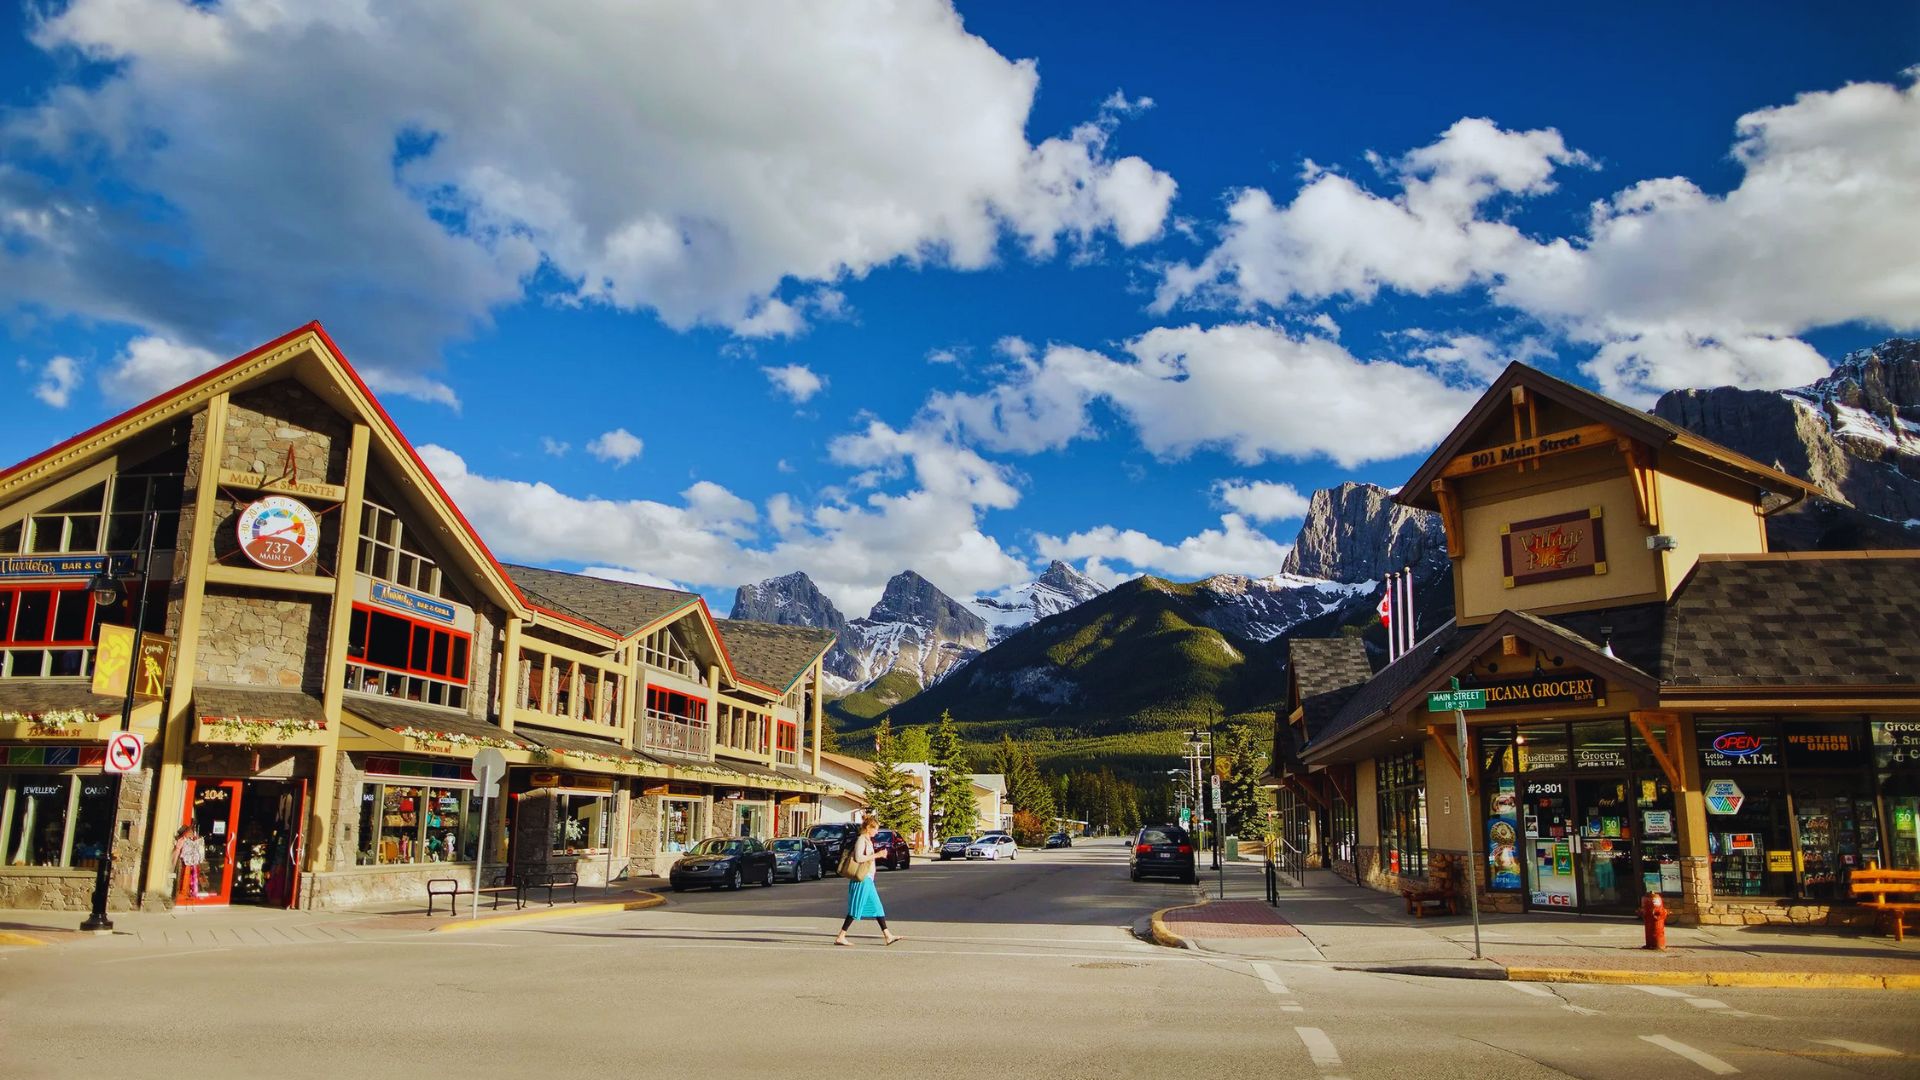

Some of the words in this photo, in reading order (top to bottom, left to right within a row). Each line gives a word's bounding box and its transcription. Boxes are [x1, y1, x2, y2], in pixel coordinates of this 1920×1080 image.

[1471, 451, 1497, 468] 801
[1501, 444, 1536, 462] Main
[1540, 433, 1581, 451] Street
[230, 472, 264, 486] MAIN
[280, 480, 336, 497] SEVENTH
[1520, 527, 1584, 552] Village
[264, 540, 290, 555] 737
[258, 552, 281, 561] MAIN
[1527, 549, 1578, 571] Plaza
[61, 562, 82, 570] BAR
[84, 561, 92, 569] &
[1484, 684, 1530, 701] TICANA
[1532, 679, 1593, 698] GROCERY
[1432, 693, 1451, 702] MAIN
[1453, 691, 1480, 701] STREET
[1884, 721, 1920, 732] Groce
[1715, 736, 1761, 750] OPEN
[1787, 735, 1849, 743] WESTERN
[1902, 735, 1920, 745] Sn
[1807, 743, 1849, 751] UNION
[1521, 753, 1566, 764] Rusticana
[1581, 750, 1620, 761] Grocery
[1704, 752, 1724, 760] Lotto
[1737, 753, 1778, 765] A.T.M.
[23, 786, 58, 795] JEWELLERY
[1527, 783, 1562, 794] #2-801
[1548, 894, 1570, 905] ICE
